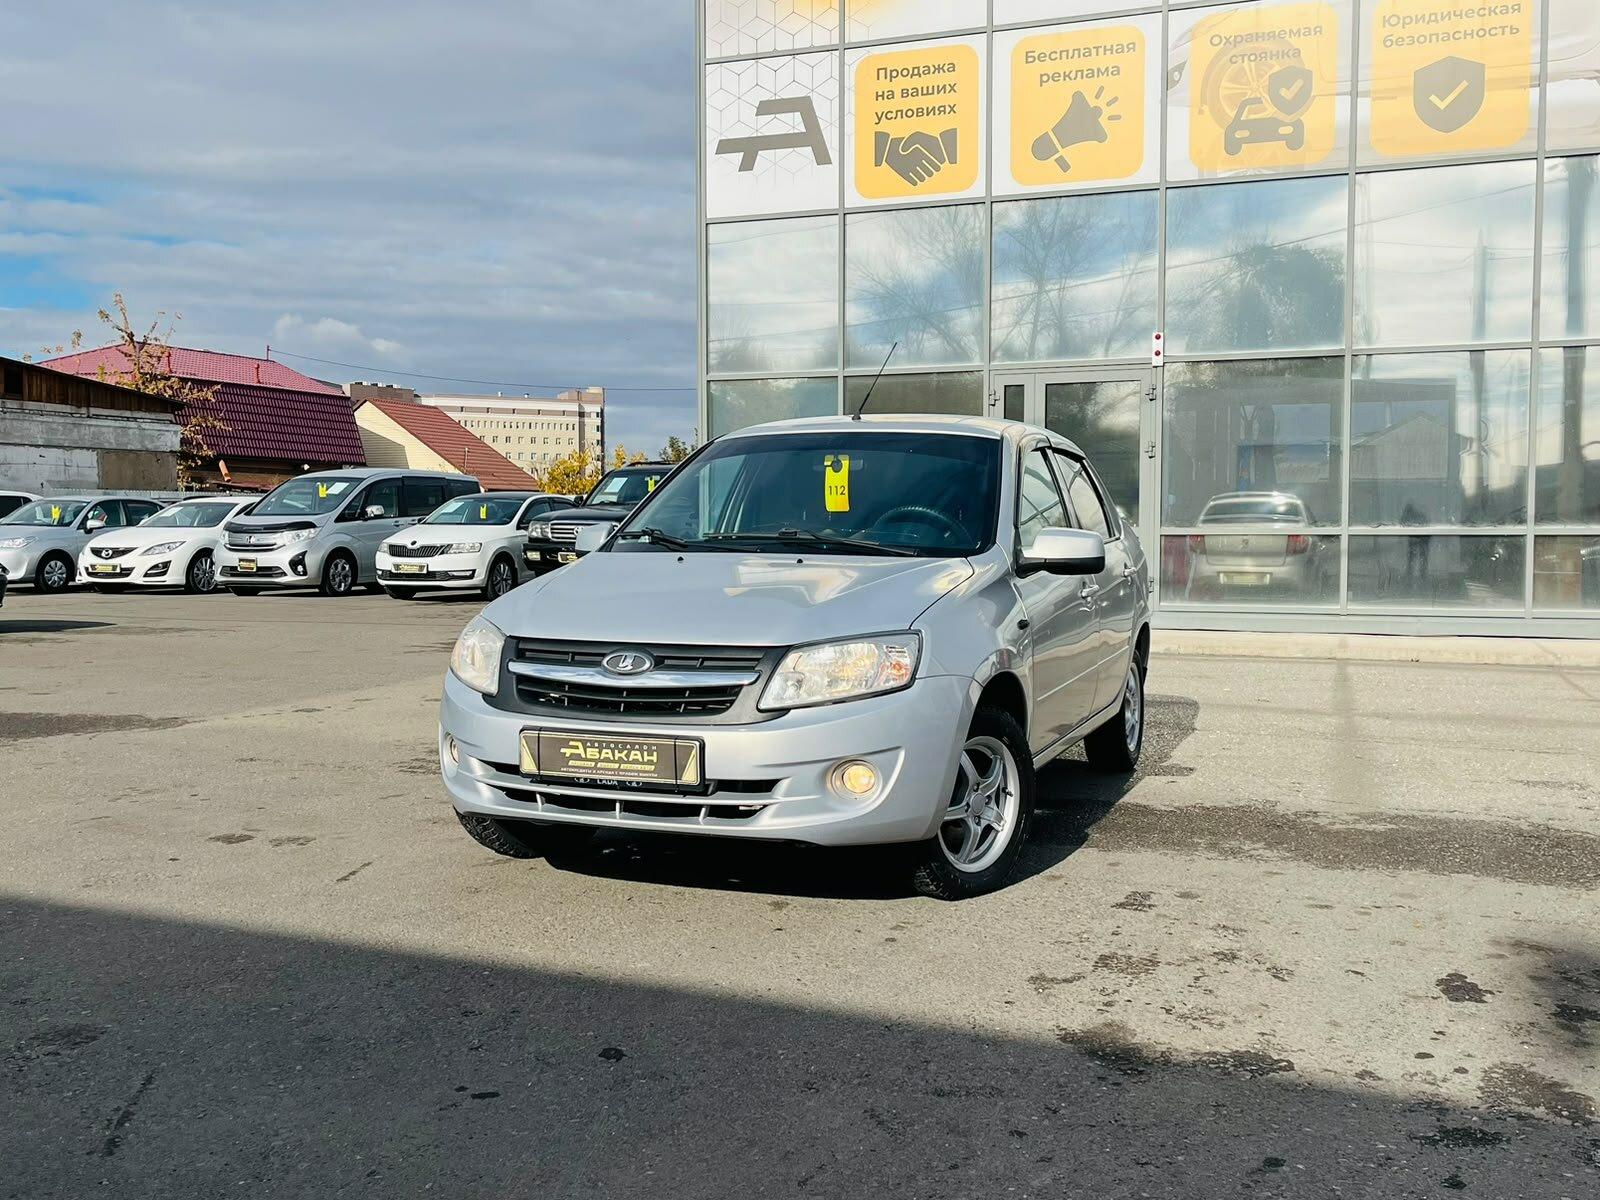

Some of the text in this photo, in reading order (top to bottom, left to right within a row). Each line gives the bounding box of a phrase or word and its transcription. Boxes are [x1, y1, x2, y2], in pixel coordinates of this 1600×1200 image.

[1382, 3, 1521, 29] Юридическая
[1209, 25, 1323, 48] Охраняемая
[1382, 24, 1521, 48] безопасность
[1025, 41, 1136, 64] Бесплатная
[1229, 47, 1302, 65] стоянка
[876, 62, 956, 82] Продажа
[1039, 64, 1120, 87] реклама
[875, 82, 958, 101] на ваших
[874, 103, 957, 125] условиях
[829, 485, 846, 496] 112
[586, 741, 657, 750] АВТОСАЛОН
